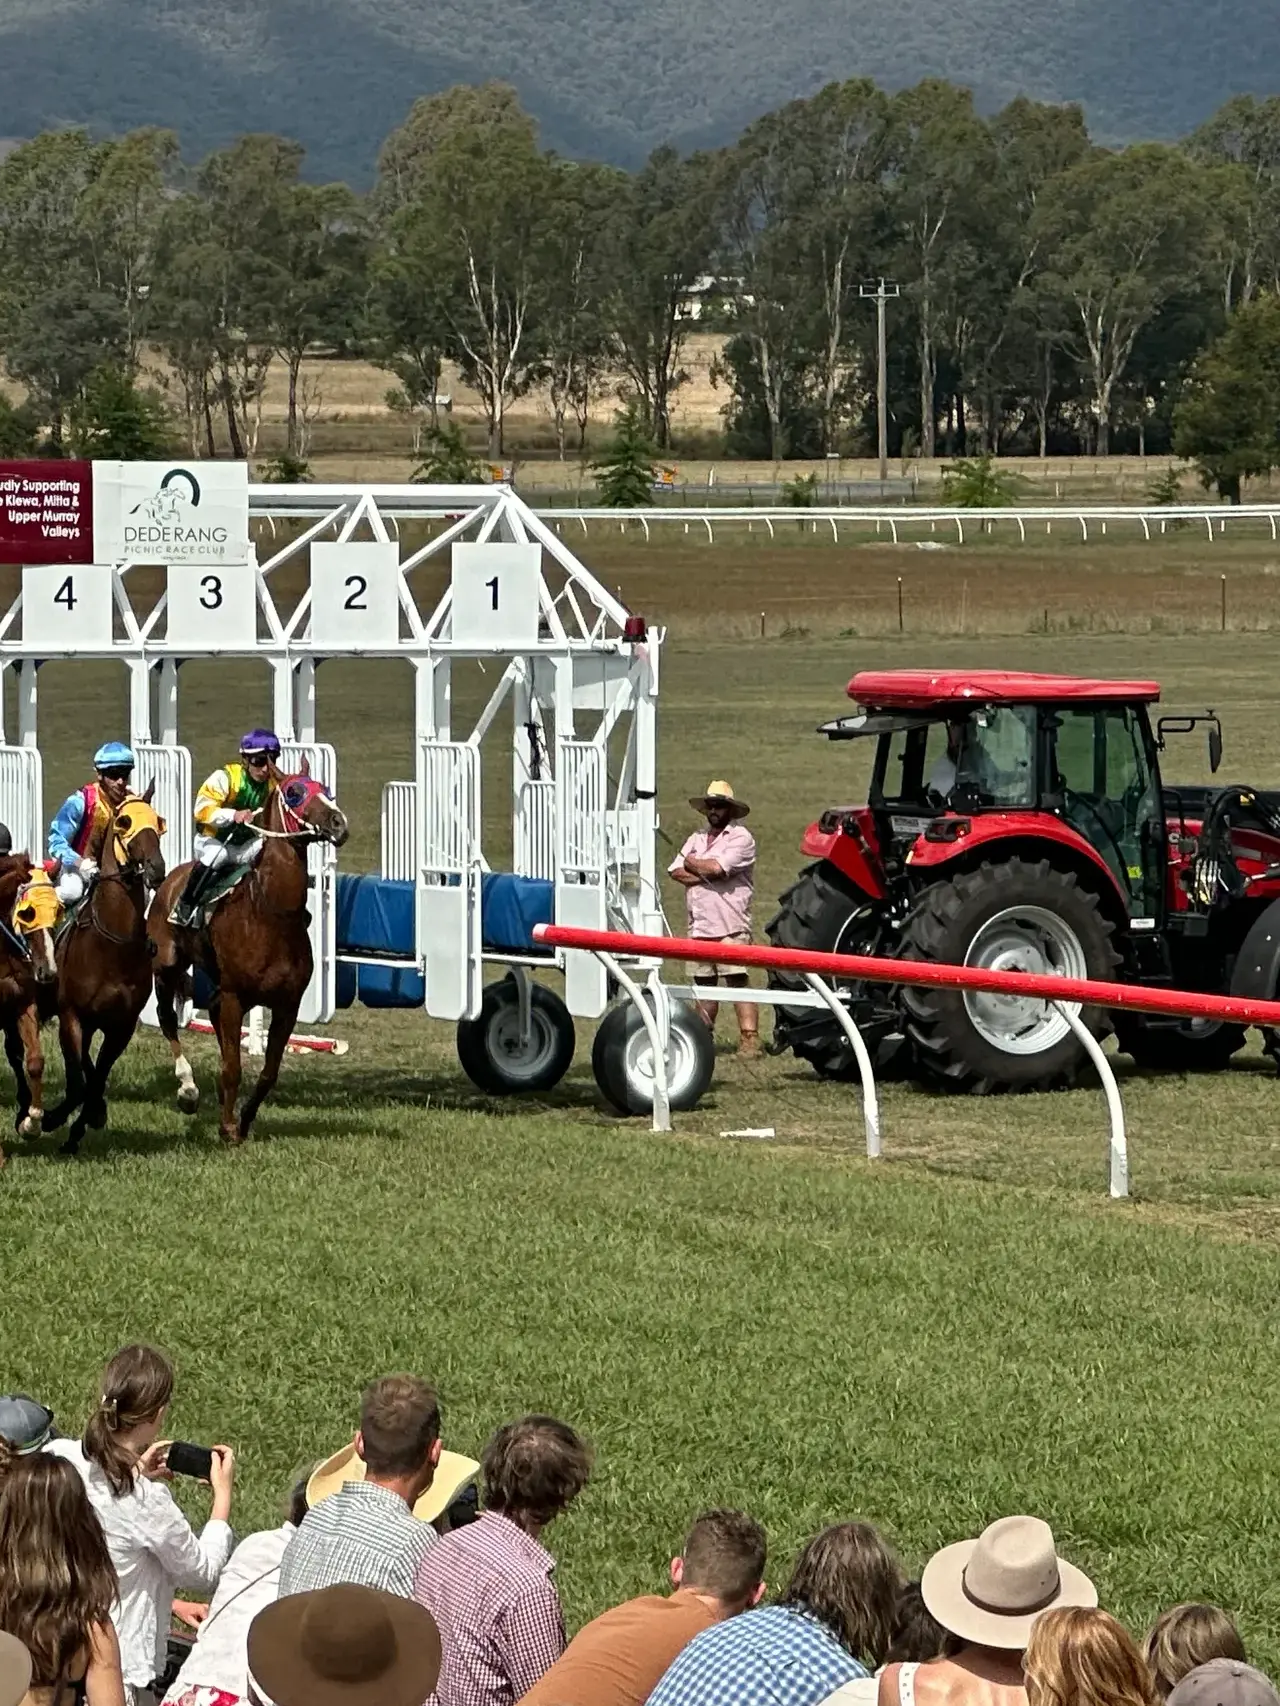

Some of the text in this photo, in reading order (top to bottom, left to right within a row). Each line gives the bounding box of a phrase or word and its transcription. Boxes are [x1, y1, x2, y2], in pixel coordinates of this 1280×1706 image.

[23, 480, 80, 494] Supporting
[6, 495, 42, 508] Kiewa,
[43, 495, 70, 507] Mitta
[71, 495, 80, 507] &
[8, 510, 80, 525] Upper Murray
[41, 525, 80, 539] Valleys
[124, 526, 228, 543] DEDERANG
[124, 545, 225, 555] PICNIC RACE CLUB
[53, 576, 78, 611] 4
[199, 575, 223, 610] 3
[343, 575, 367, 610] 2
[485, 576, 499, 611] 1
